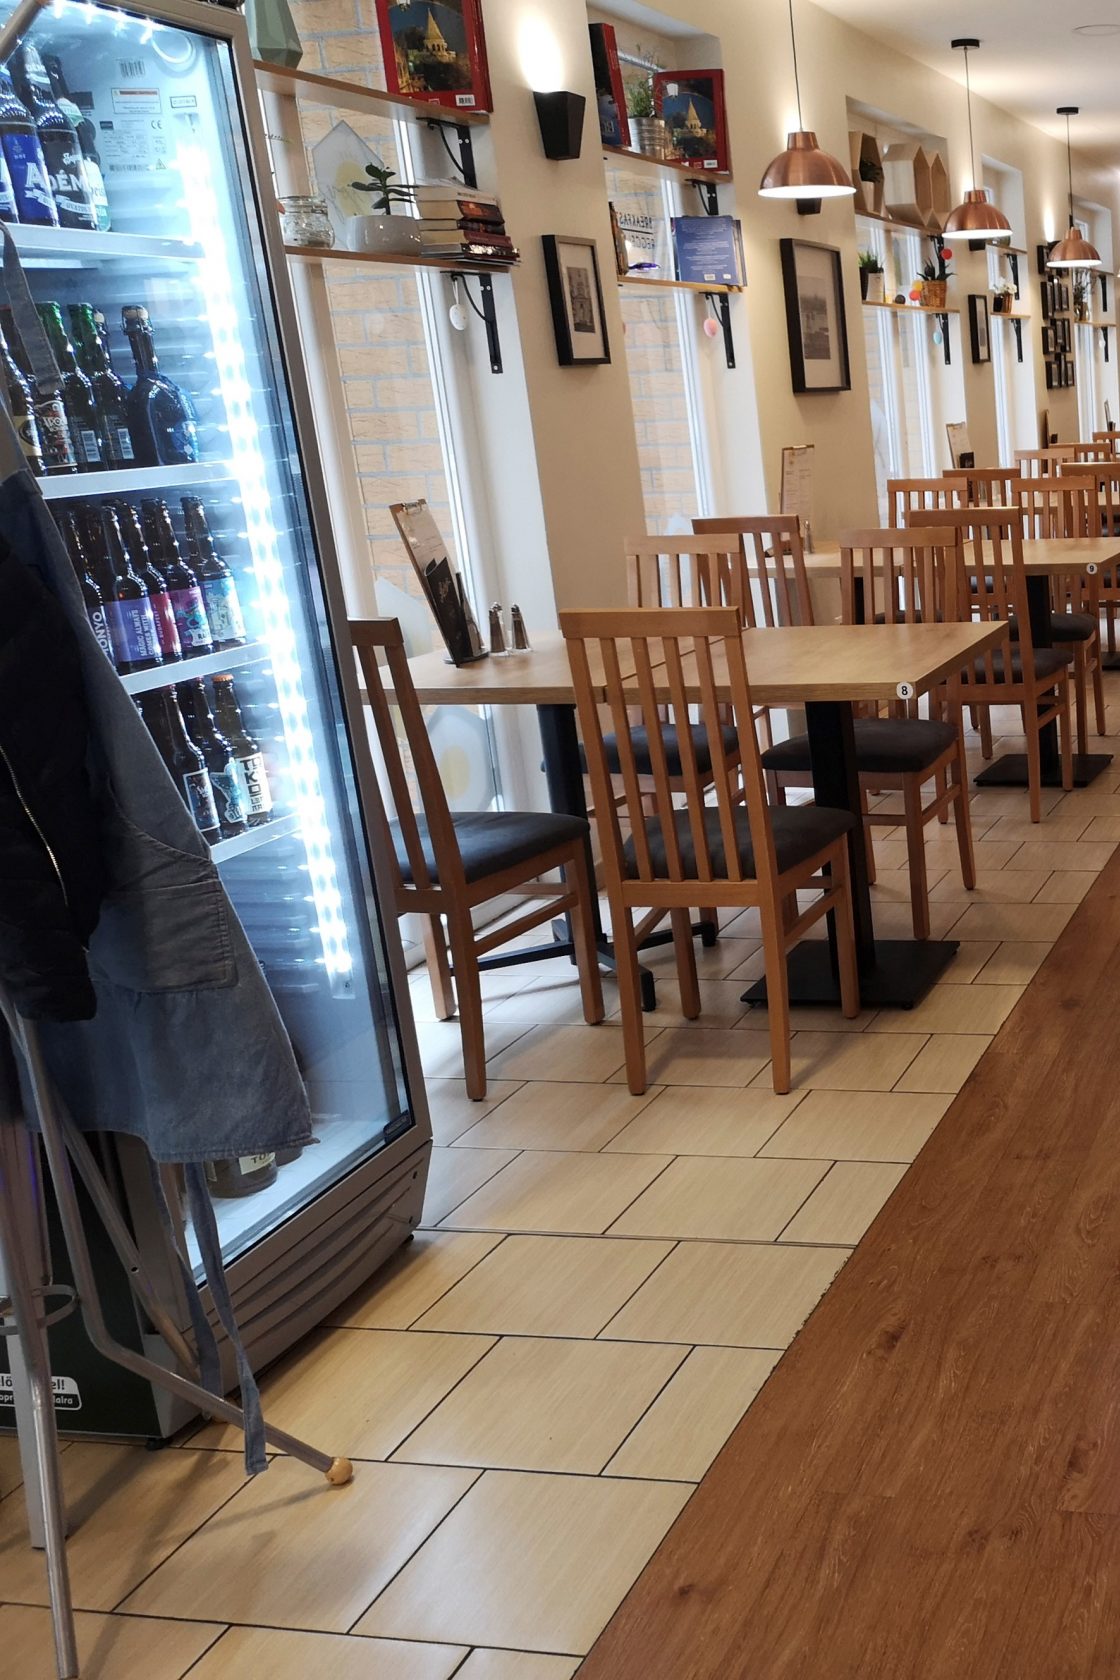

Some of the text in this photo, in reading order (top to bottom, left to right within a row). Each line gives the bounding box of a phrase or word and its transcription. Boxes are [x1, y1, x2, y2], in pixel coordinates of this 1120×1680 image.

[1089, 565, 1095, 573] 9
[136, 634, 148, 657] MAGIC
[901, 685, 908, 696] 8
